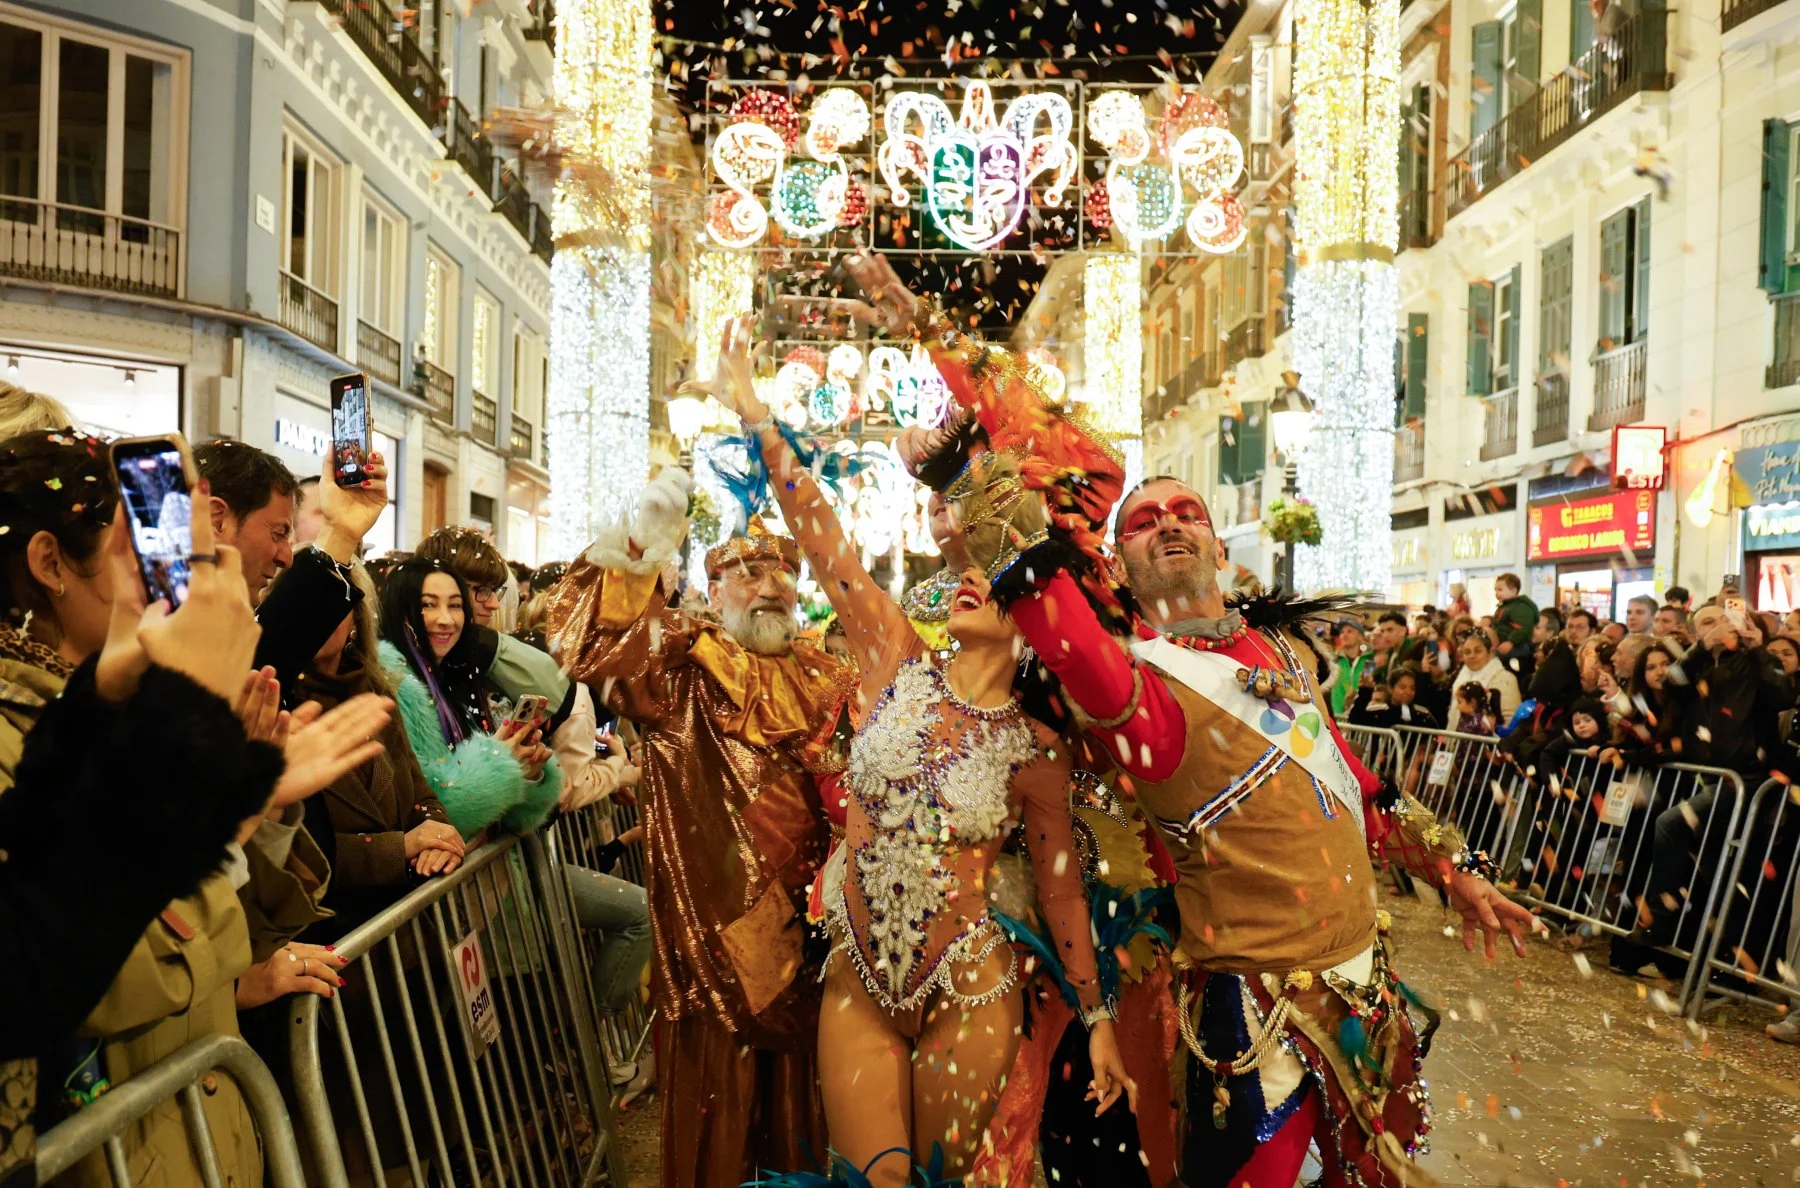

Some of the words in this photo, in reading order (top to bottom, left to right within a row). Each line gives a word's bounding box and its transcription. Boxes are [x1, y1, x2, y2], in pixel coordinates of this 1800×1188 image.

[279, 417, 332, 457] PARFO
[1330, 743, 1348, 781] Dios
[471, 986, 490, 1023] esm
